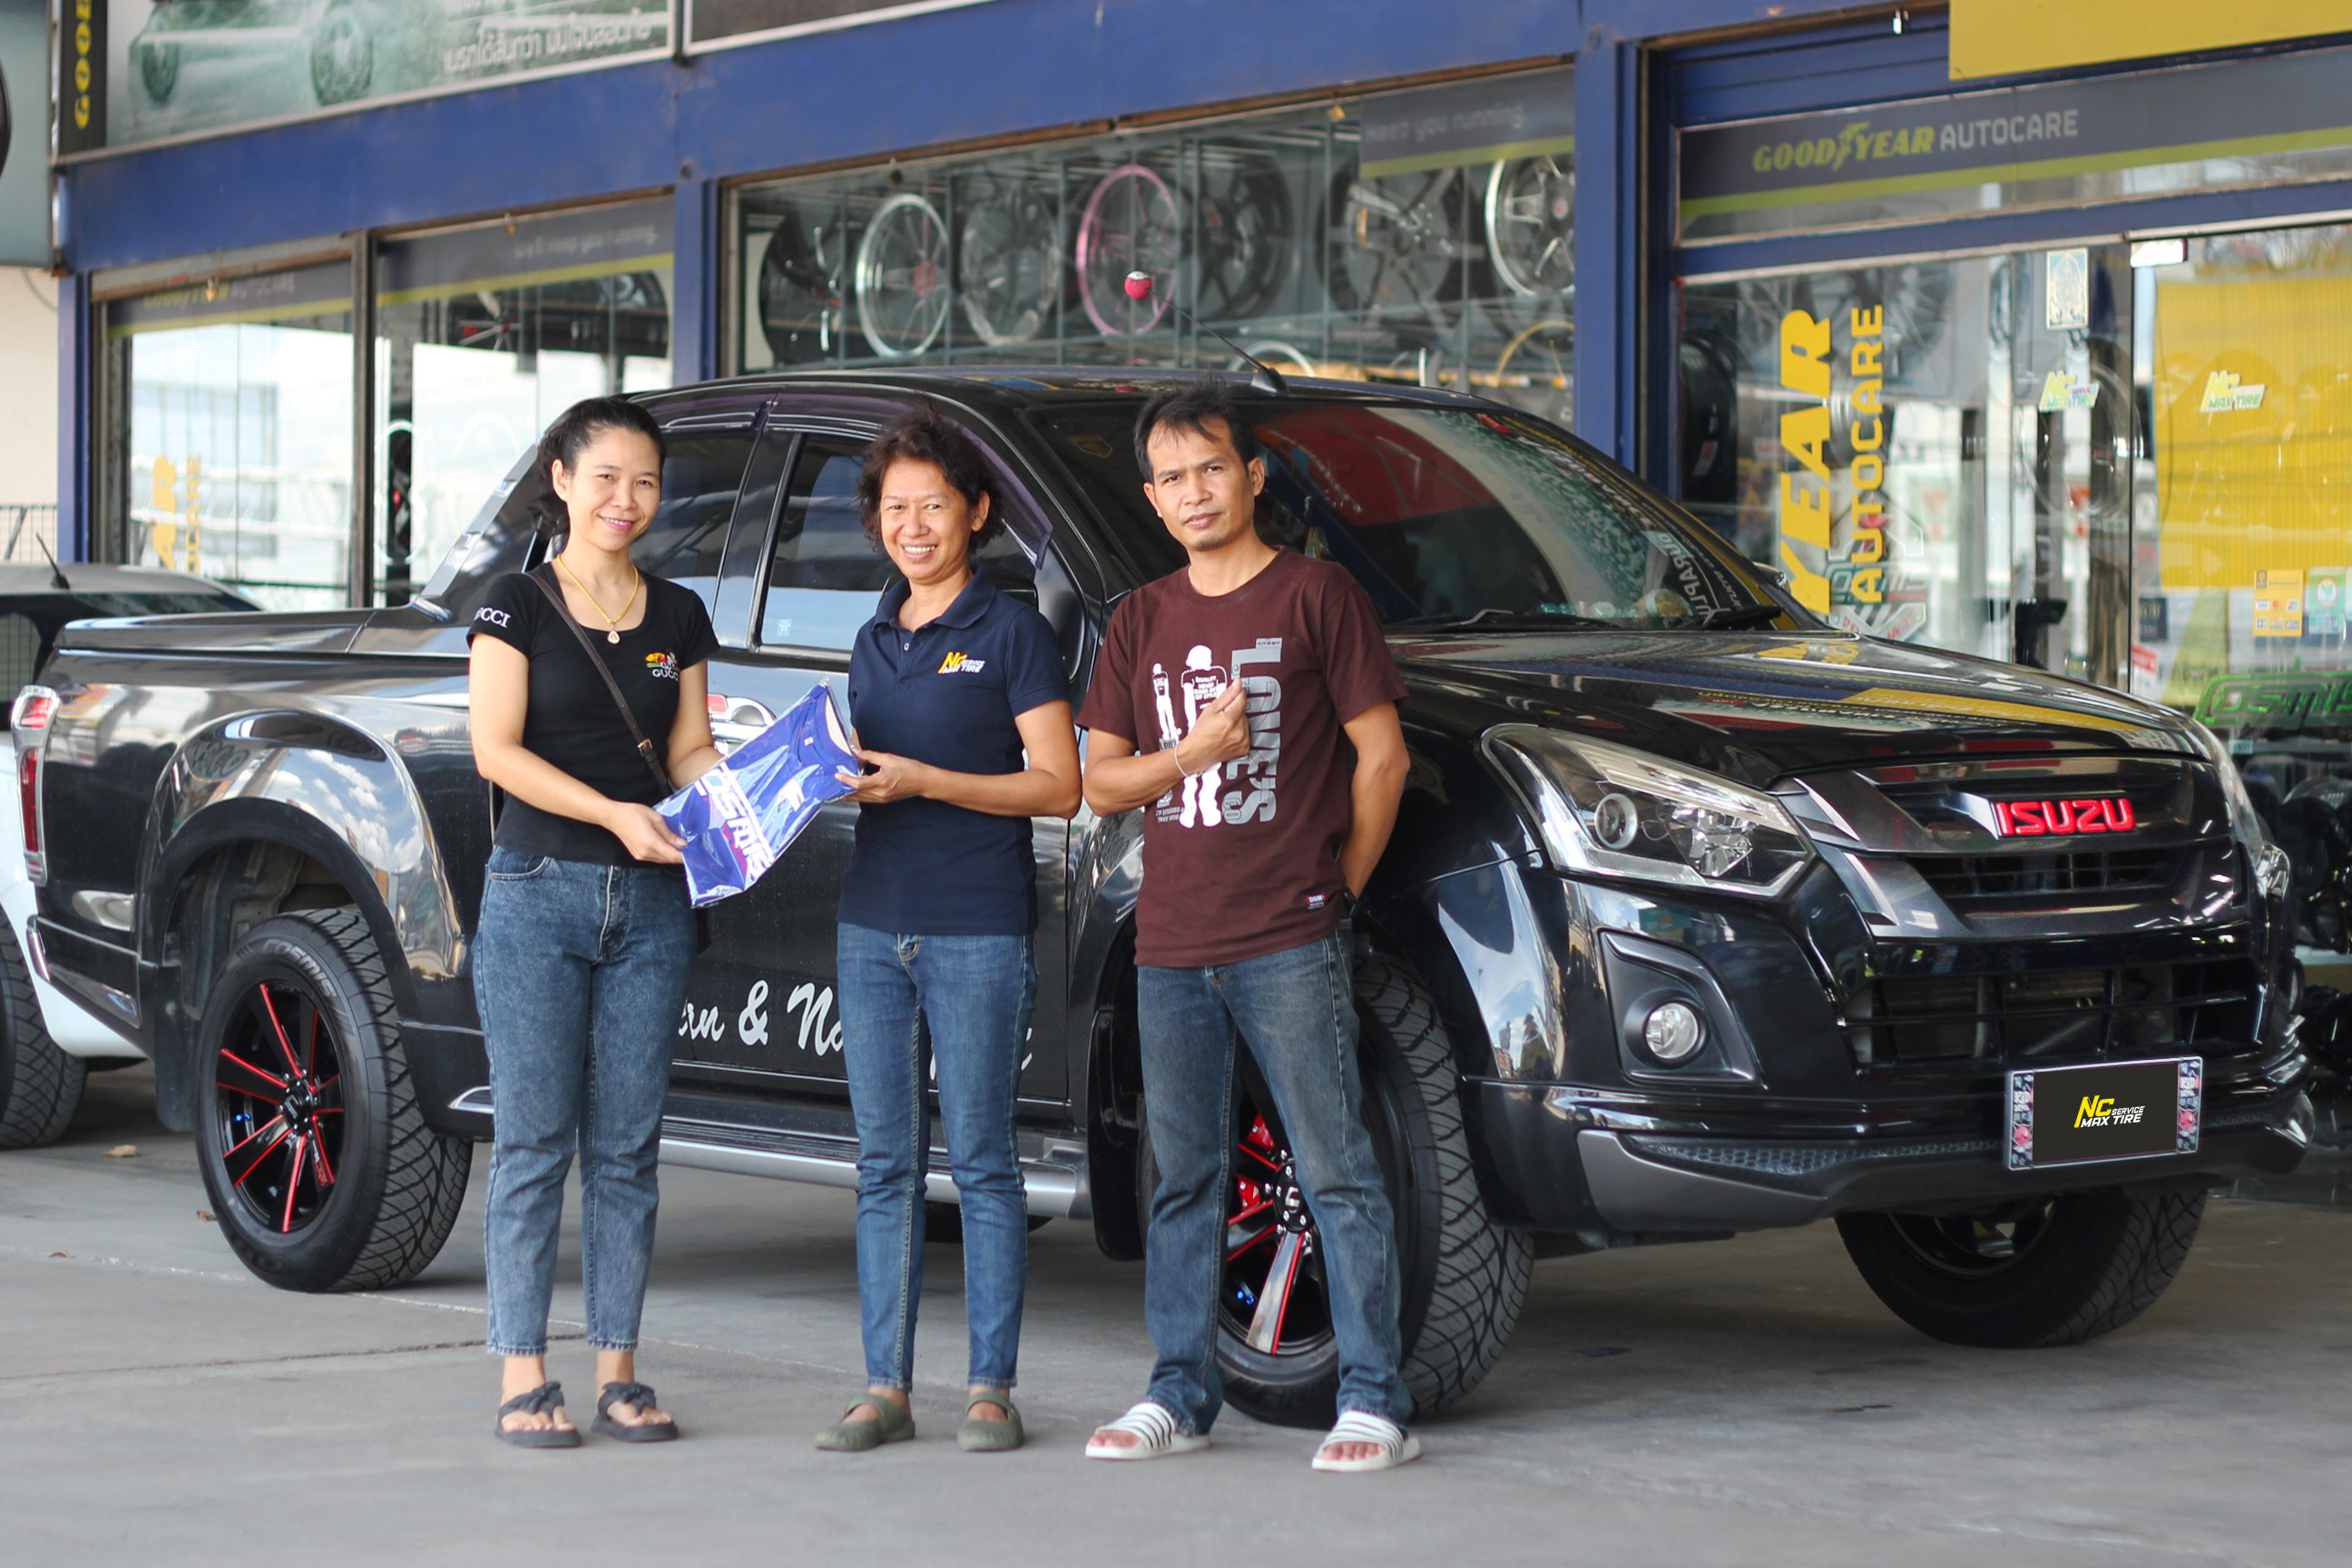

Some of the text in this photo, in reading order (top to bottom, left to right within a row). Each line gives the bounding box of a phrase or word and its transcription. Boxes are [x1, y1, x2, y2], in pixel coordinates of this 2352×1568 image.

[1751, 109, 2079, 172] GOODYEAR AUTOCARE
[1851, 305, 1883, 604] AUTOCARE
[1995, 799, 2136, 836] ISUZU
[739, 979, 769, 1045] &
